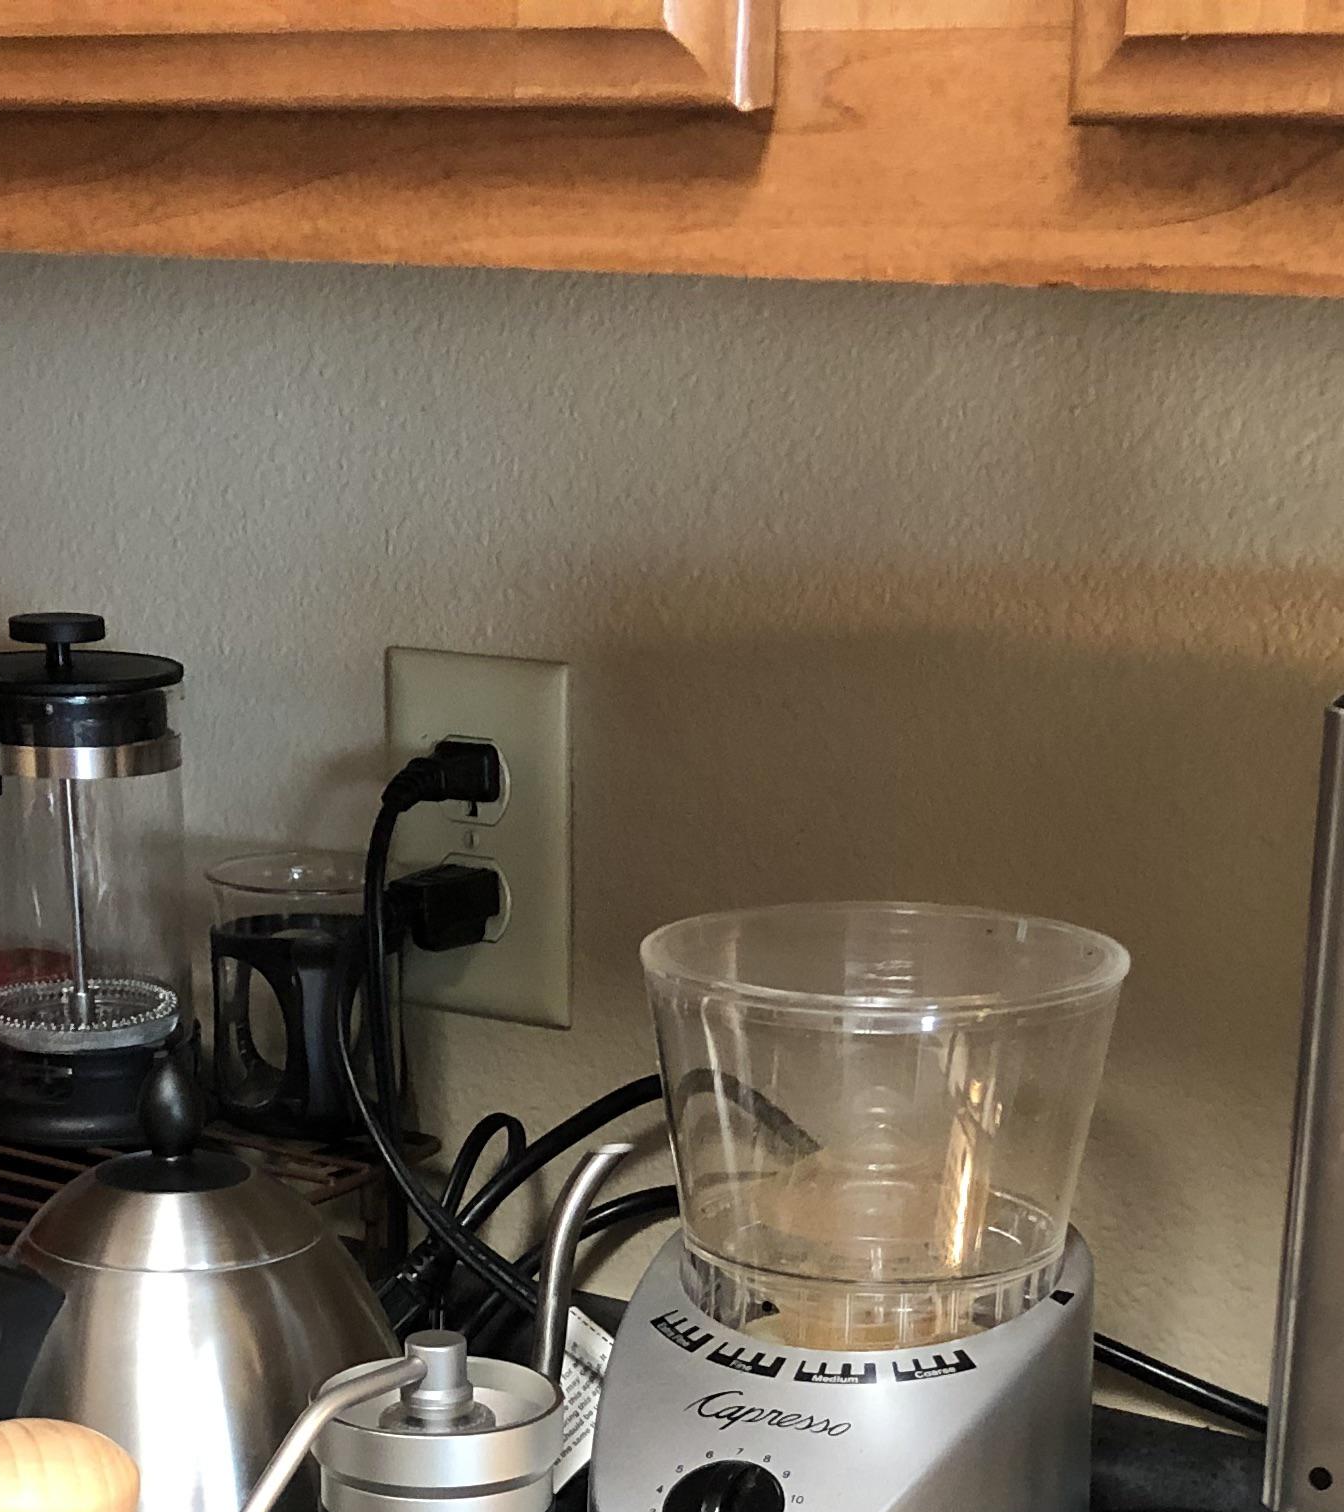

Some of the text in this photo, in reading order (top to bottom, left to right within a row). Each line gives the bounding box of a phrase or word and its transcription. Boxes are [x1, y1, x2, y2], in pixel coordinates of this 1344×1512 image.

[914, 1366, 956, 1379] Coarse
[812, 1375, 858, 1384] Medium
[684, 1391, 851, 1436] Capresso
[706, 1451, 714, 1459] 6
[763, 1455, 771, 1463] 8
[676, 1465, 684, 1473] 5
[656, 1485, 663, 1493] 4
[791, 1495, 804, 1504] 10
